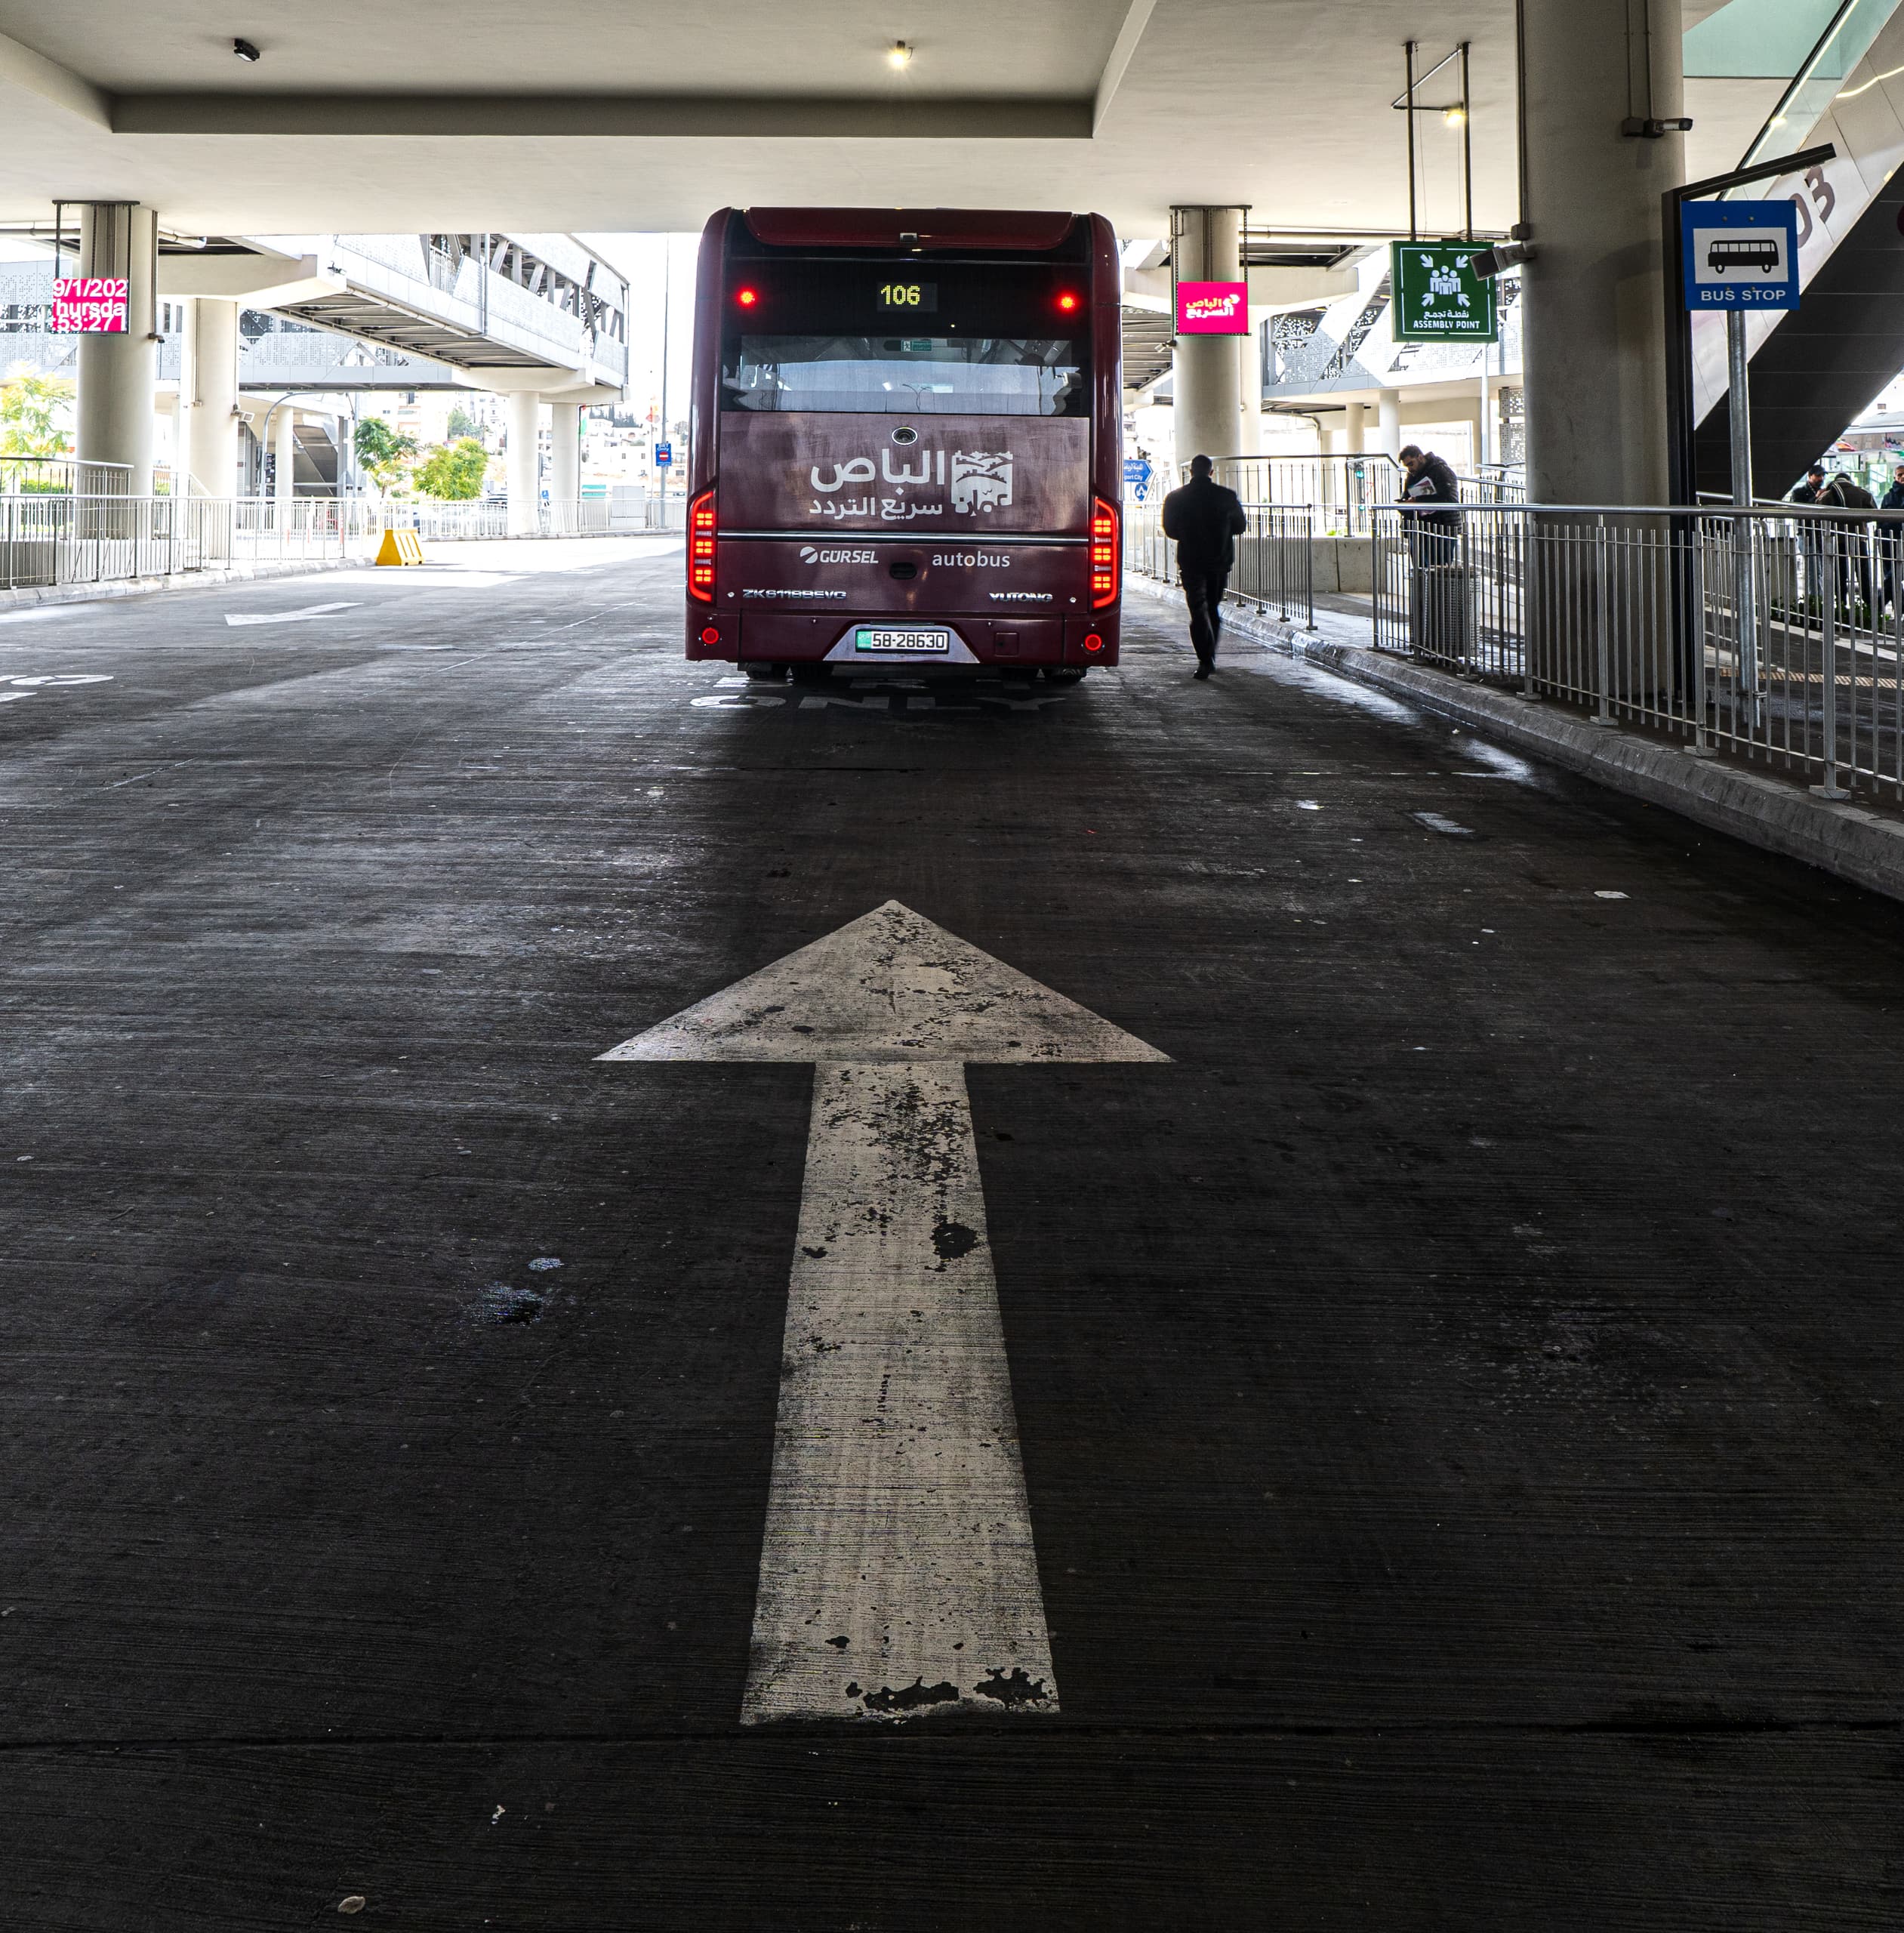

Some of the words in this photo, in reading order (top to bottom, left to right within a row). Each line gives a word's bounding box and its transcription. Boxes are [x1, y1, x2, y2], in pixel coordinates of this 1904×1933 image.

[53, 279, 128, 298] 9/1/202
[880, 285, 920, 305] 106
[1701, 290, 1736, 301] BUS
[1741, 289, 1786, 301] STOP
[53, 298, 127, 316] hursda
[1185, 298, 1222, 310] الباص
[1423, 311, 1446, 320] تجمع
[1446, 310, 1470, 318] نقطة
[1413, 320, 1454, 329] ASSEMBLY
[1456, 320, 1480, 329] POINT
[811, 448, 945, 496] الباص
[809, 497, 876, 520] التردد
[880, 498, 943, 521] سريع
[819, 550, 879, 564] GÜRSEL
[932, 550, 1011, 567] autobus
[988, 592, 1054, 603] YUTONG
[872, 633, 945, 649] 58-28630
[689, 695, 1066, 711] ONLY
